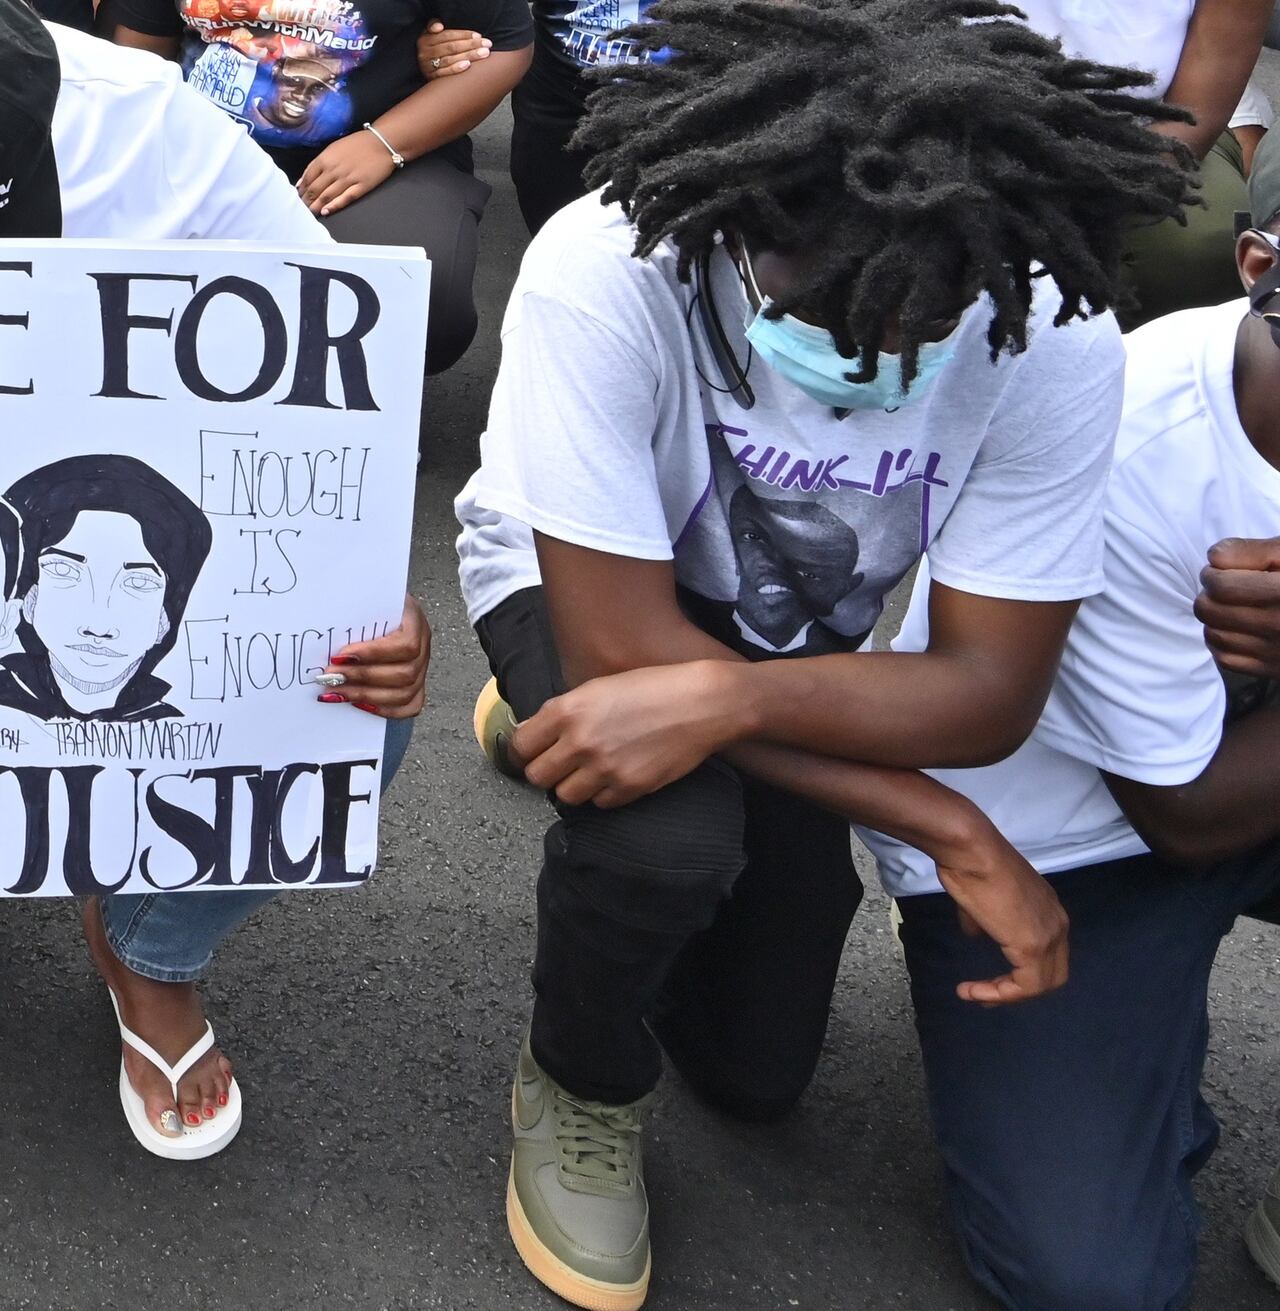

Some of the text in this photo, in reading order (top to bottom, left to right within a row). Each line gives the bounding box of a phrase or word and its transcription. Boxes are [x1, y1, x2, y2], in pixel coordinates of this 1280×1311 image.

[88, 262, 382, 412] FOR
[199, 429, 372, 522] ENOUGH
[233, 528, 302, 596] IS
[139, 720, 223, 760] MARTIN
